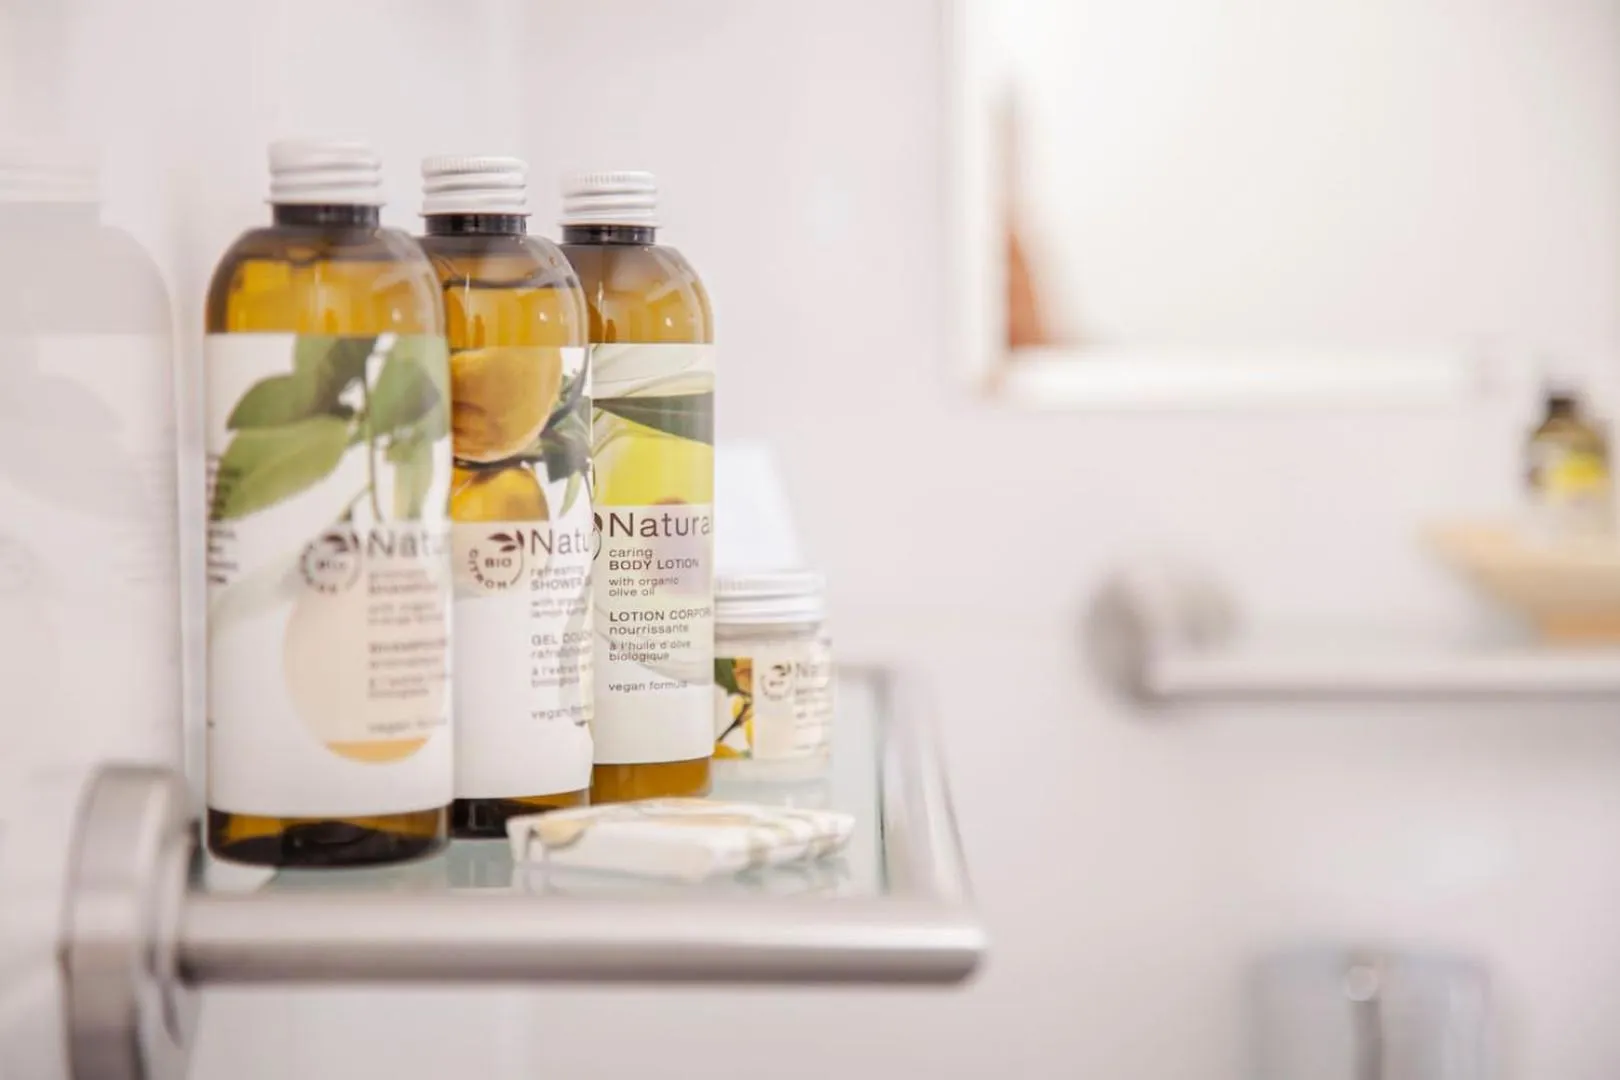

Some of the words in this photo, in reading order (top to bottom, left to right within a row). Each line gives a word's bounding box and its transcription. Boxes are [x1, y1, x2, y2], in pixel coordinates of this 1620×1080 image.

[608, 548, 653, 559] caring
[485, 557, 512, 568] BIO
[608, 560, 652, 571] BODY
[657, 558, 700, 570] LOTION
[608, 576, 634, 586] with
[639, 576, 679, 588] organic
[608, 587, 638, 597] olive
[641, 586, 655, 597] oil
[609, 610, 665, 622] LOTION
[608, 624, 689, 636] nourrissante
[531, 634, 558, 646] GEL
[609, 651, 670, 663] biologique
[608, 683, 645, 694] vegan
